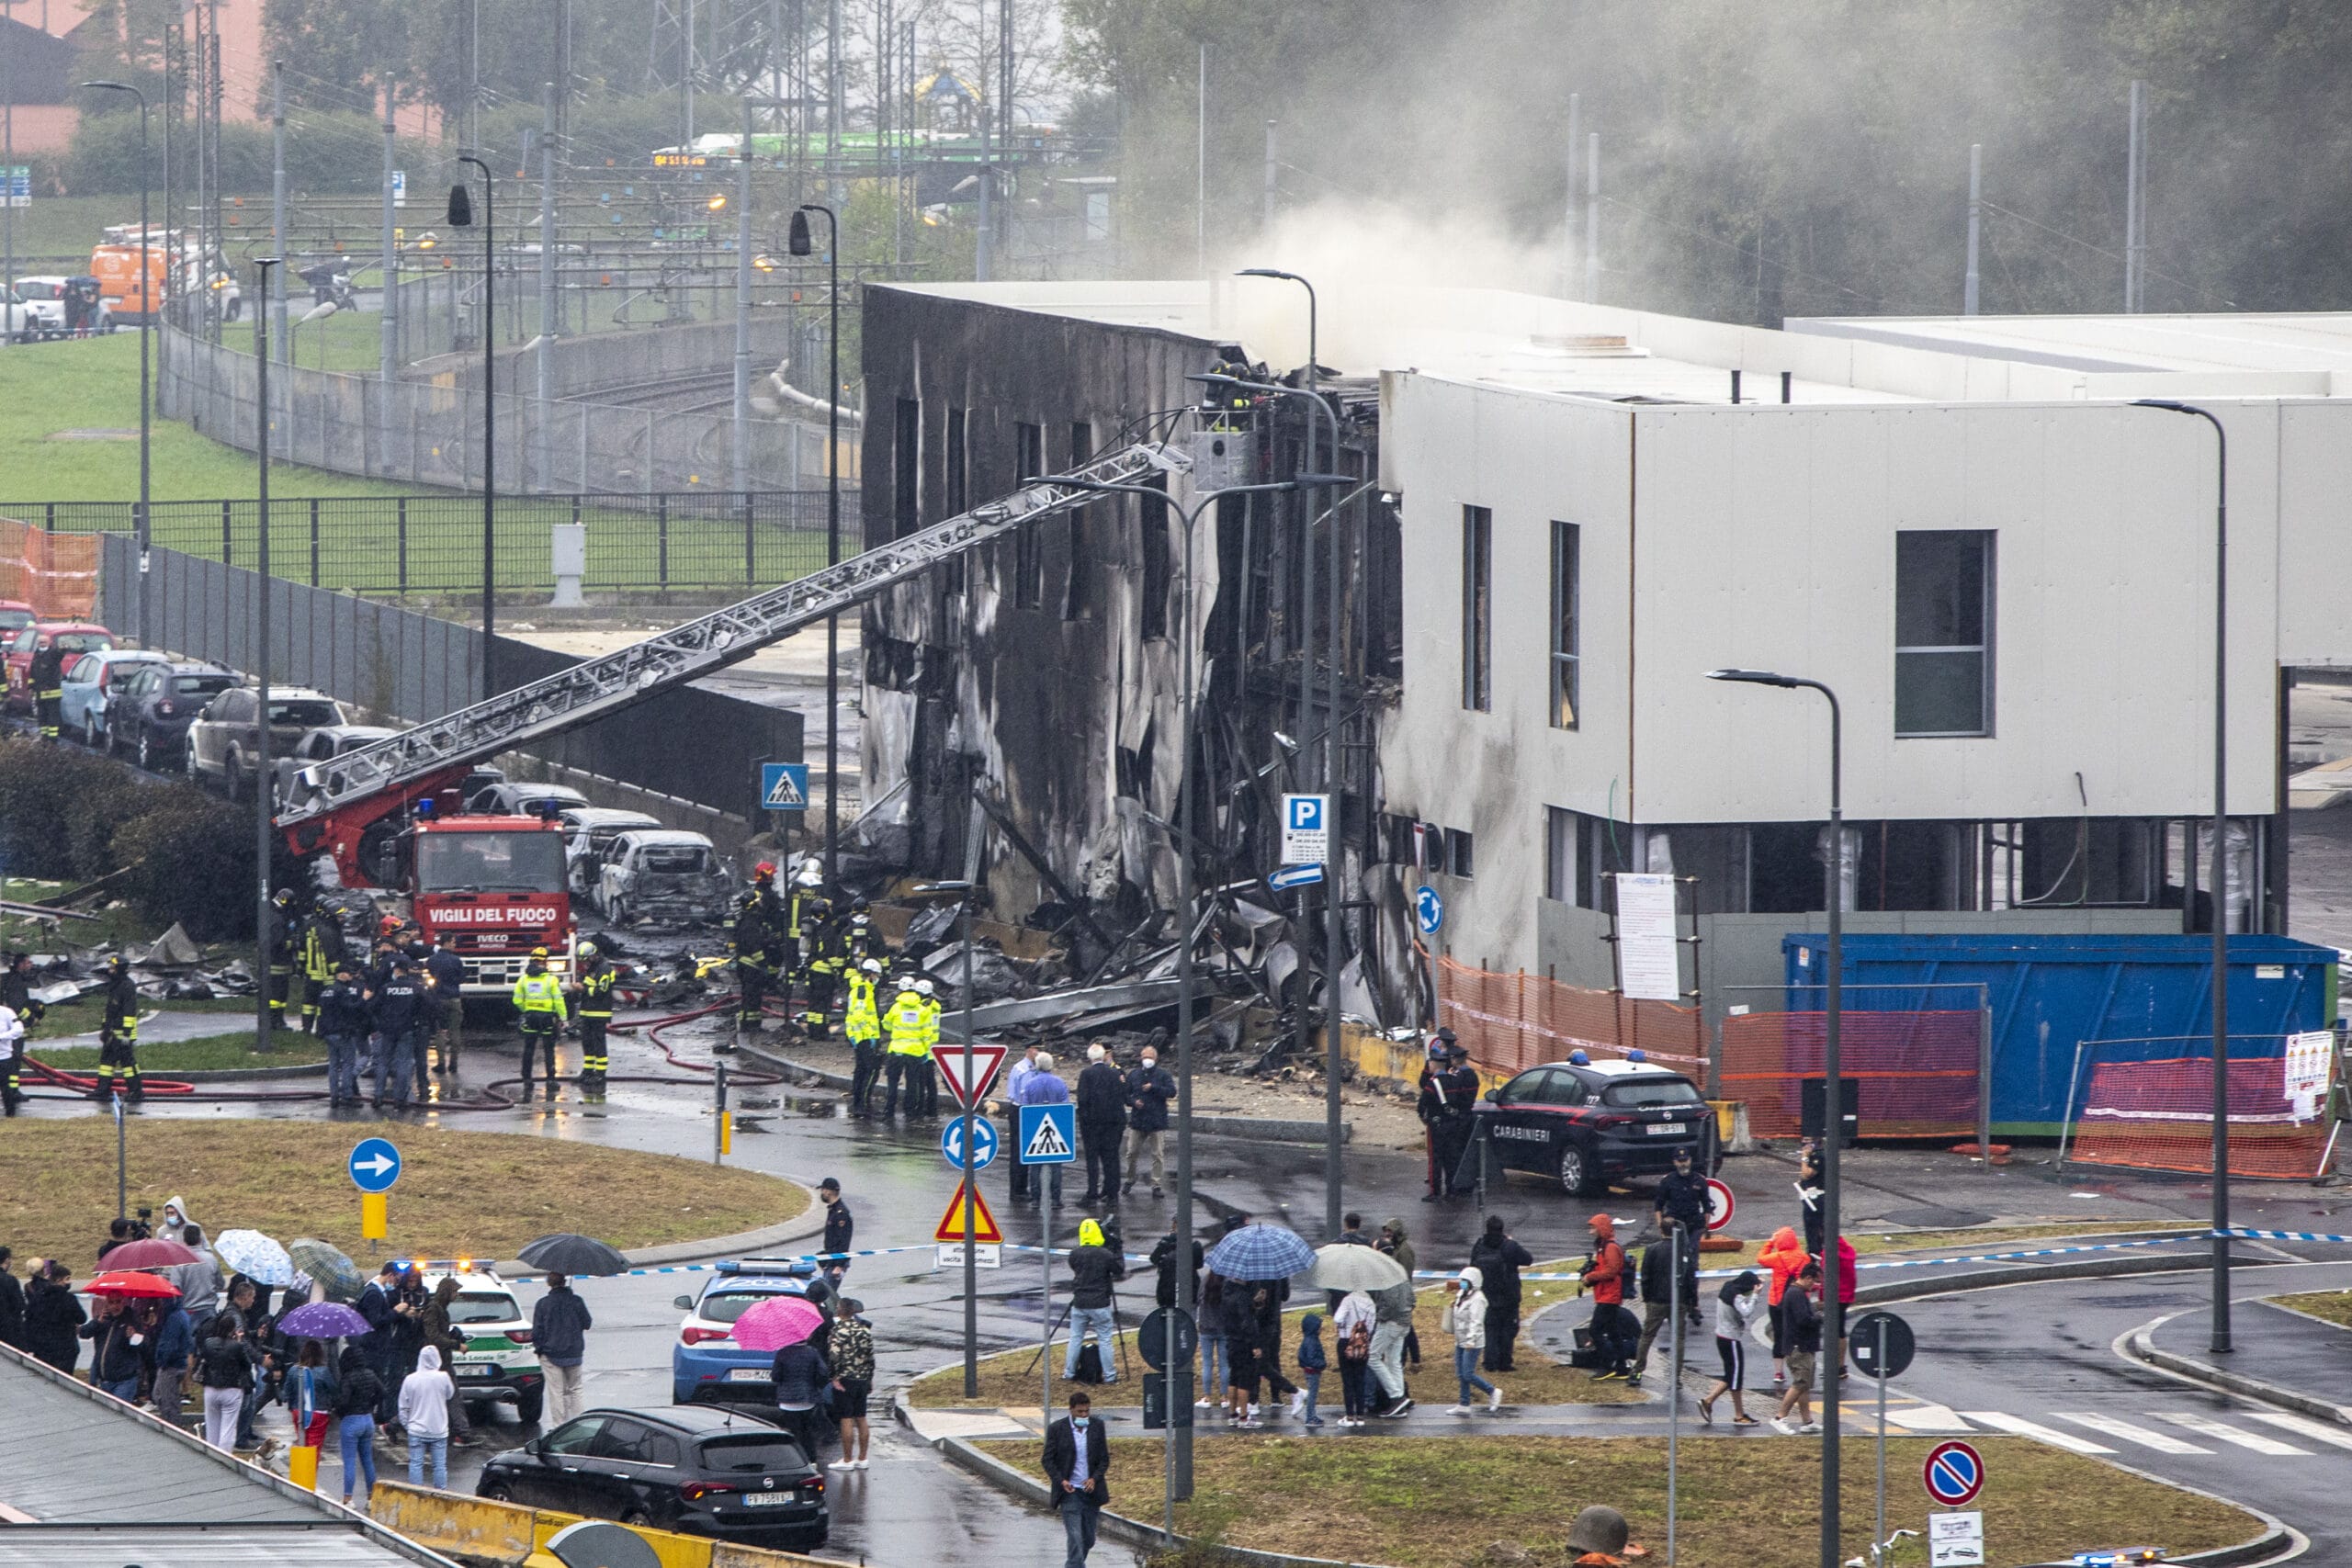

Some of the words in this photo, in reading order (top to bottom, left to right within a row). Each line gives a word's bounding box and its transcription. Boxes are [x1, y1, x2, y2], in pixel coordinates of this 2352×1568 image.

[1296, 801, 1317, 826] P
[429, 908, 472, 922] VIGILI
[475, 908, 504, 921] DEL
[506, 908, 557, 921] FUOCO
[477, 934, 509, 942] IVECO
[387, 987, 413, 996] POLIZIA
[1493, 1125, 1550, 1143] CARABINIERI
